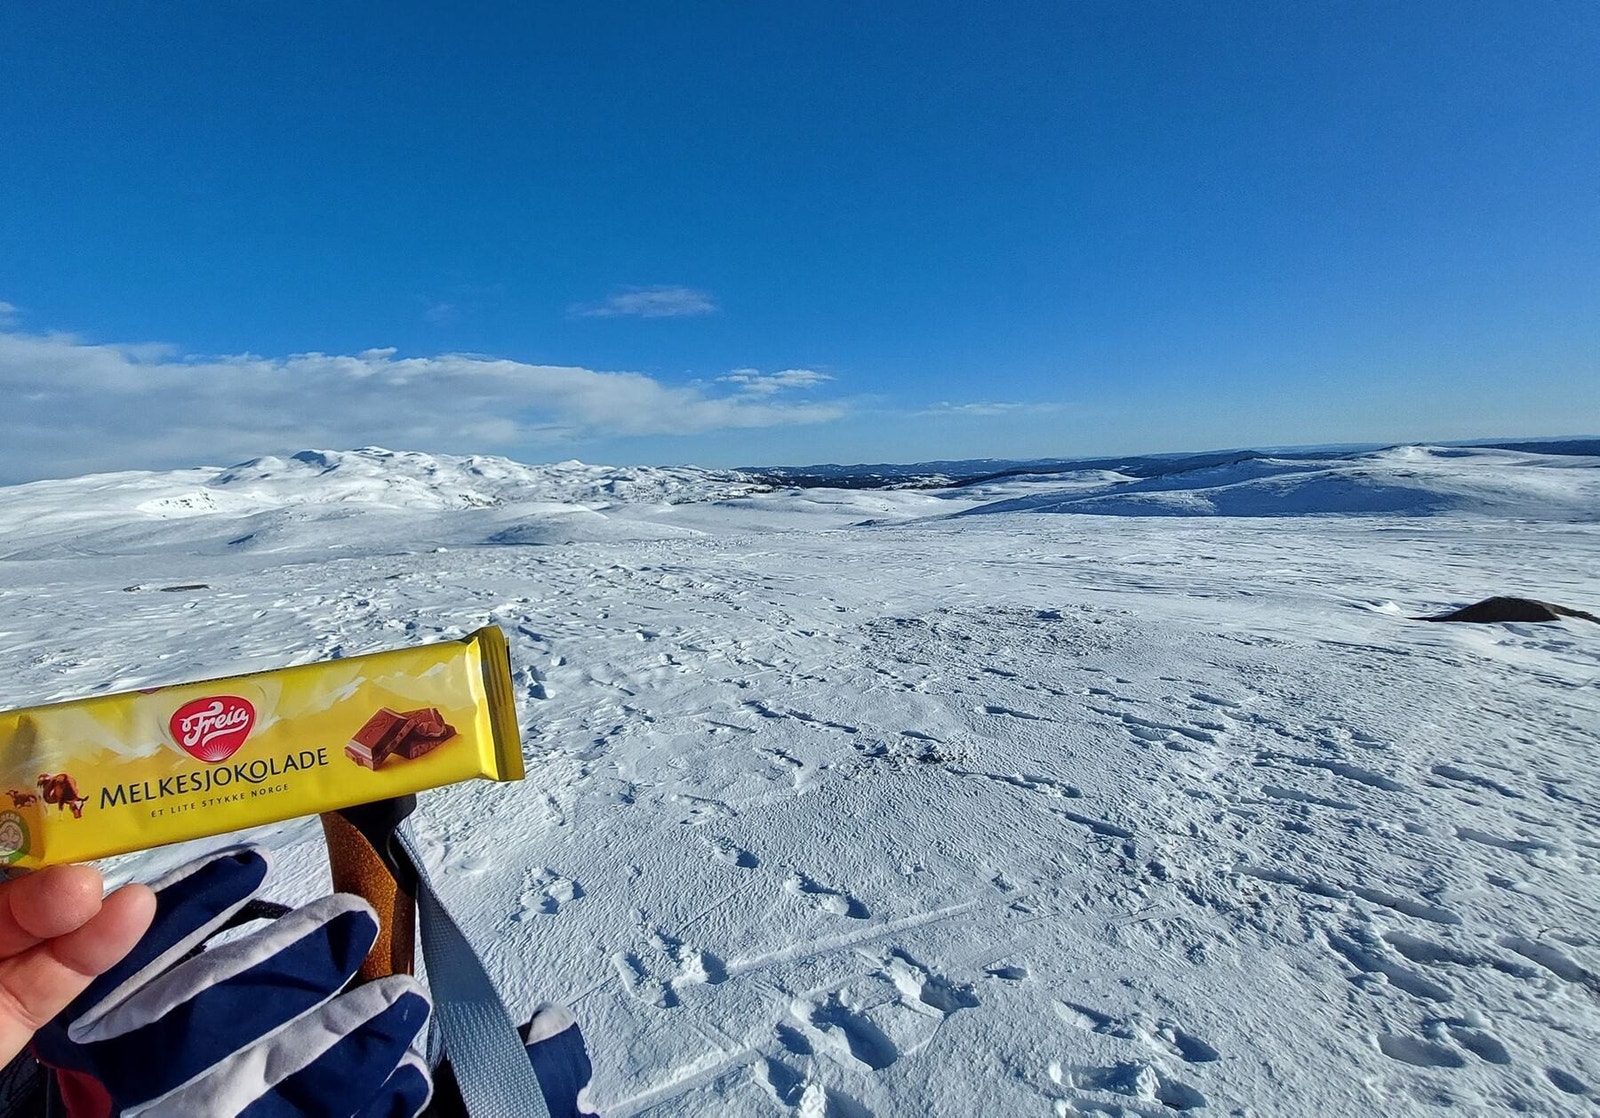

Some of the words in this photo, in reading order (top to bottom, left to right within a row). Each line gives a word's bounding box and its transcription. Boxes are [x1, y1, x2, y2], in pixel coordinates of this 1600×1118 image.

[179, 701, 249, 747] Freia
[100, 747, 329, 810] MELKESJOKOLADE
[151, 809, 164, 818] ET
[171, 804, 196, 814] LITE
[202, 793, 246, 808] STYKKE
[251, 784, 289, 797] NORGE
